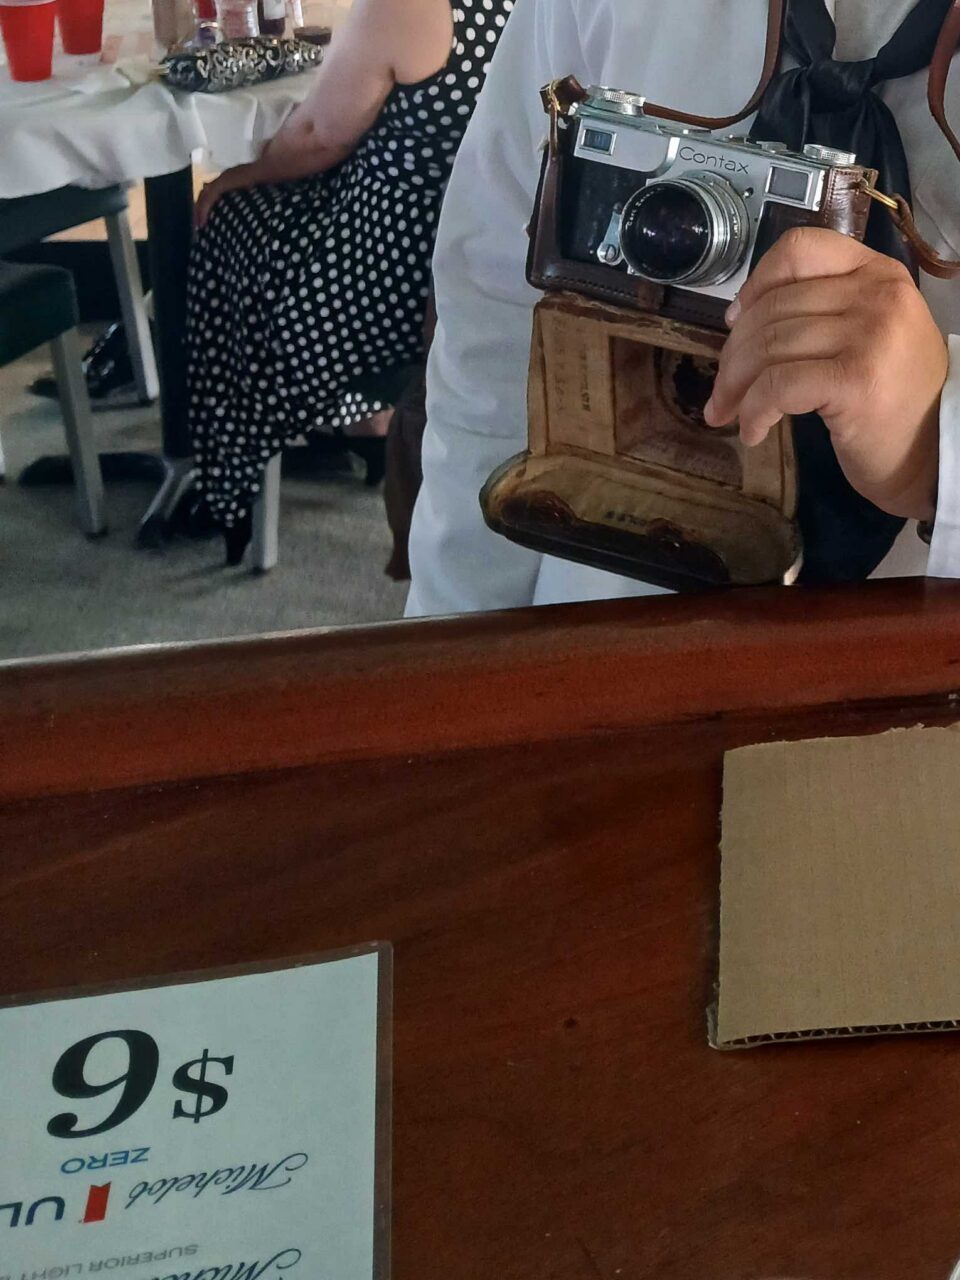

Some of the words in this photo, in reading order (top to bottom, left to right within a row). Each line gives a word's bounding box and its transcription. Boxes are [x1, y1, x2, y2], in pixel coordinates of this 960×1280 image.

[678, 146, 750, 176] Contax
[46, 1029, 235, 1139] $6
[60, 1146, 151, 1175] ZERO
[124, 1152, 309, 1210] Michelob
[88, 1243, 199, 1272] SUPERIOR
